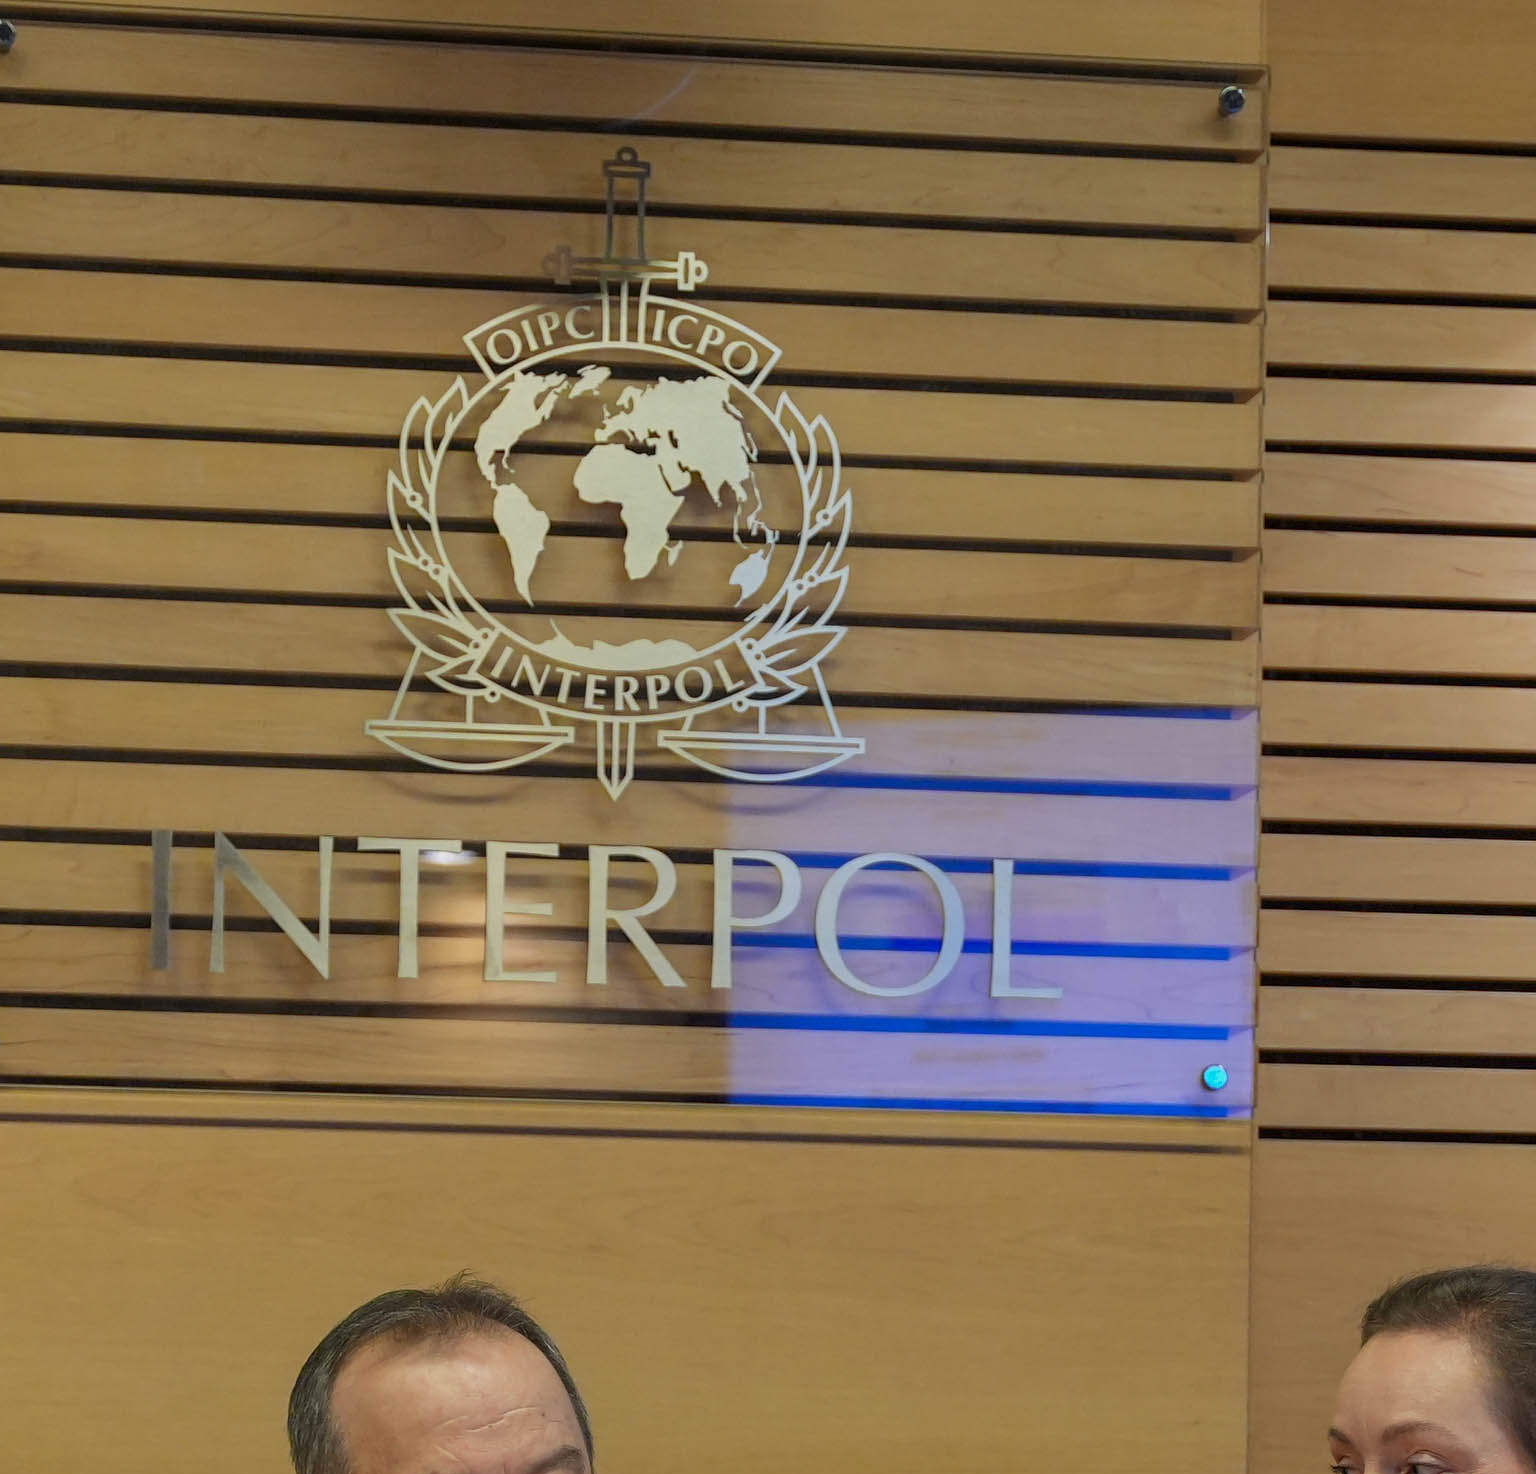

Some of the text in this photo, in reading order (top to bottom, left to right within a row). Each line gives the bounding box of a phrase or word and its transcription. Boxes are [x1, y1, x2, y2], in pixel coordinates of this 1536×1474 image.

[484, 304, 759, 377] OIPC ICPO
[492, 644, 746, 713] INTERPOL
[150, 829, 1064, 999] INTERPOL
